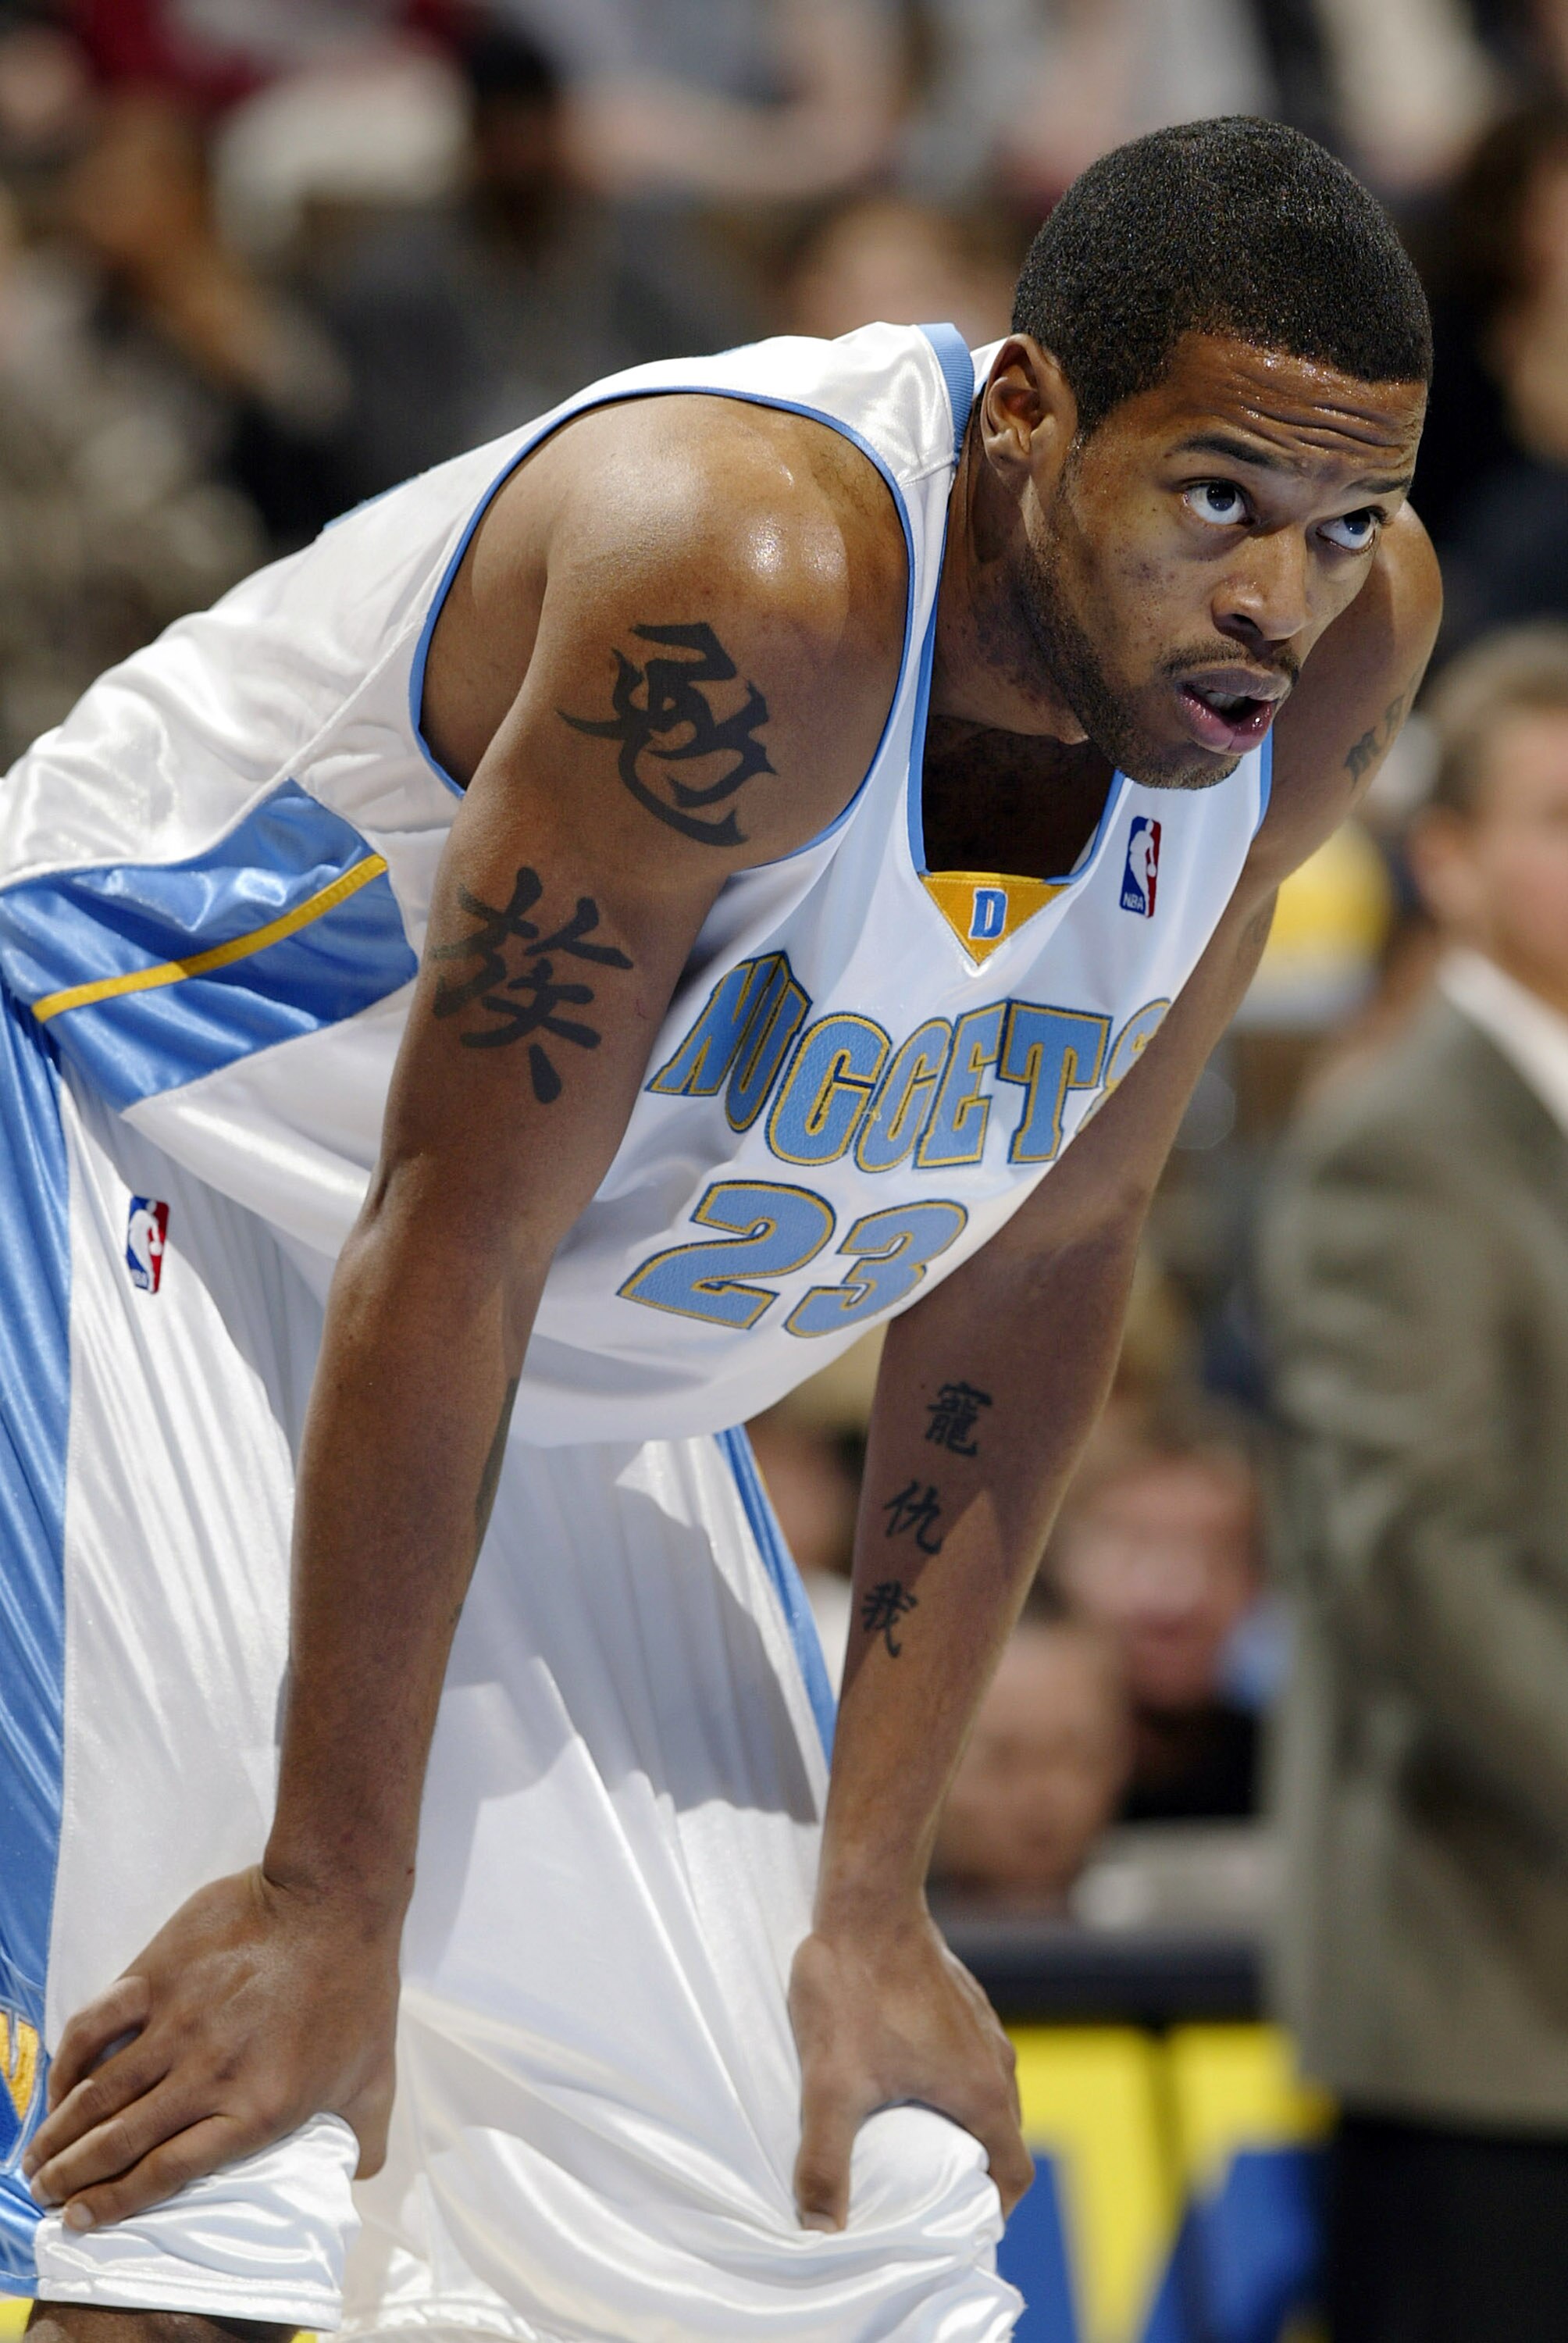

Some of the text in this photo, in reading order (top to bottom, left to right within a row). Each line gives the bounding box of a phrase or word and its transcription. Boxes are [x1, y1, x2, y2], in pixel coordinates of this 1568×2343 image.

[968, 887, 1007, 940] D
[1123, 891, 1145, 911] NBA
[617, 1180, 968, 1338] 23
